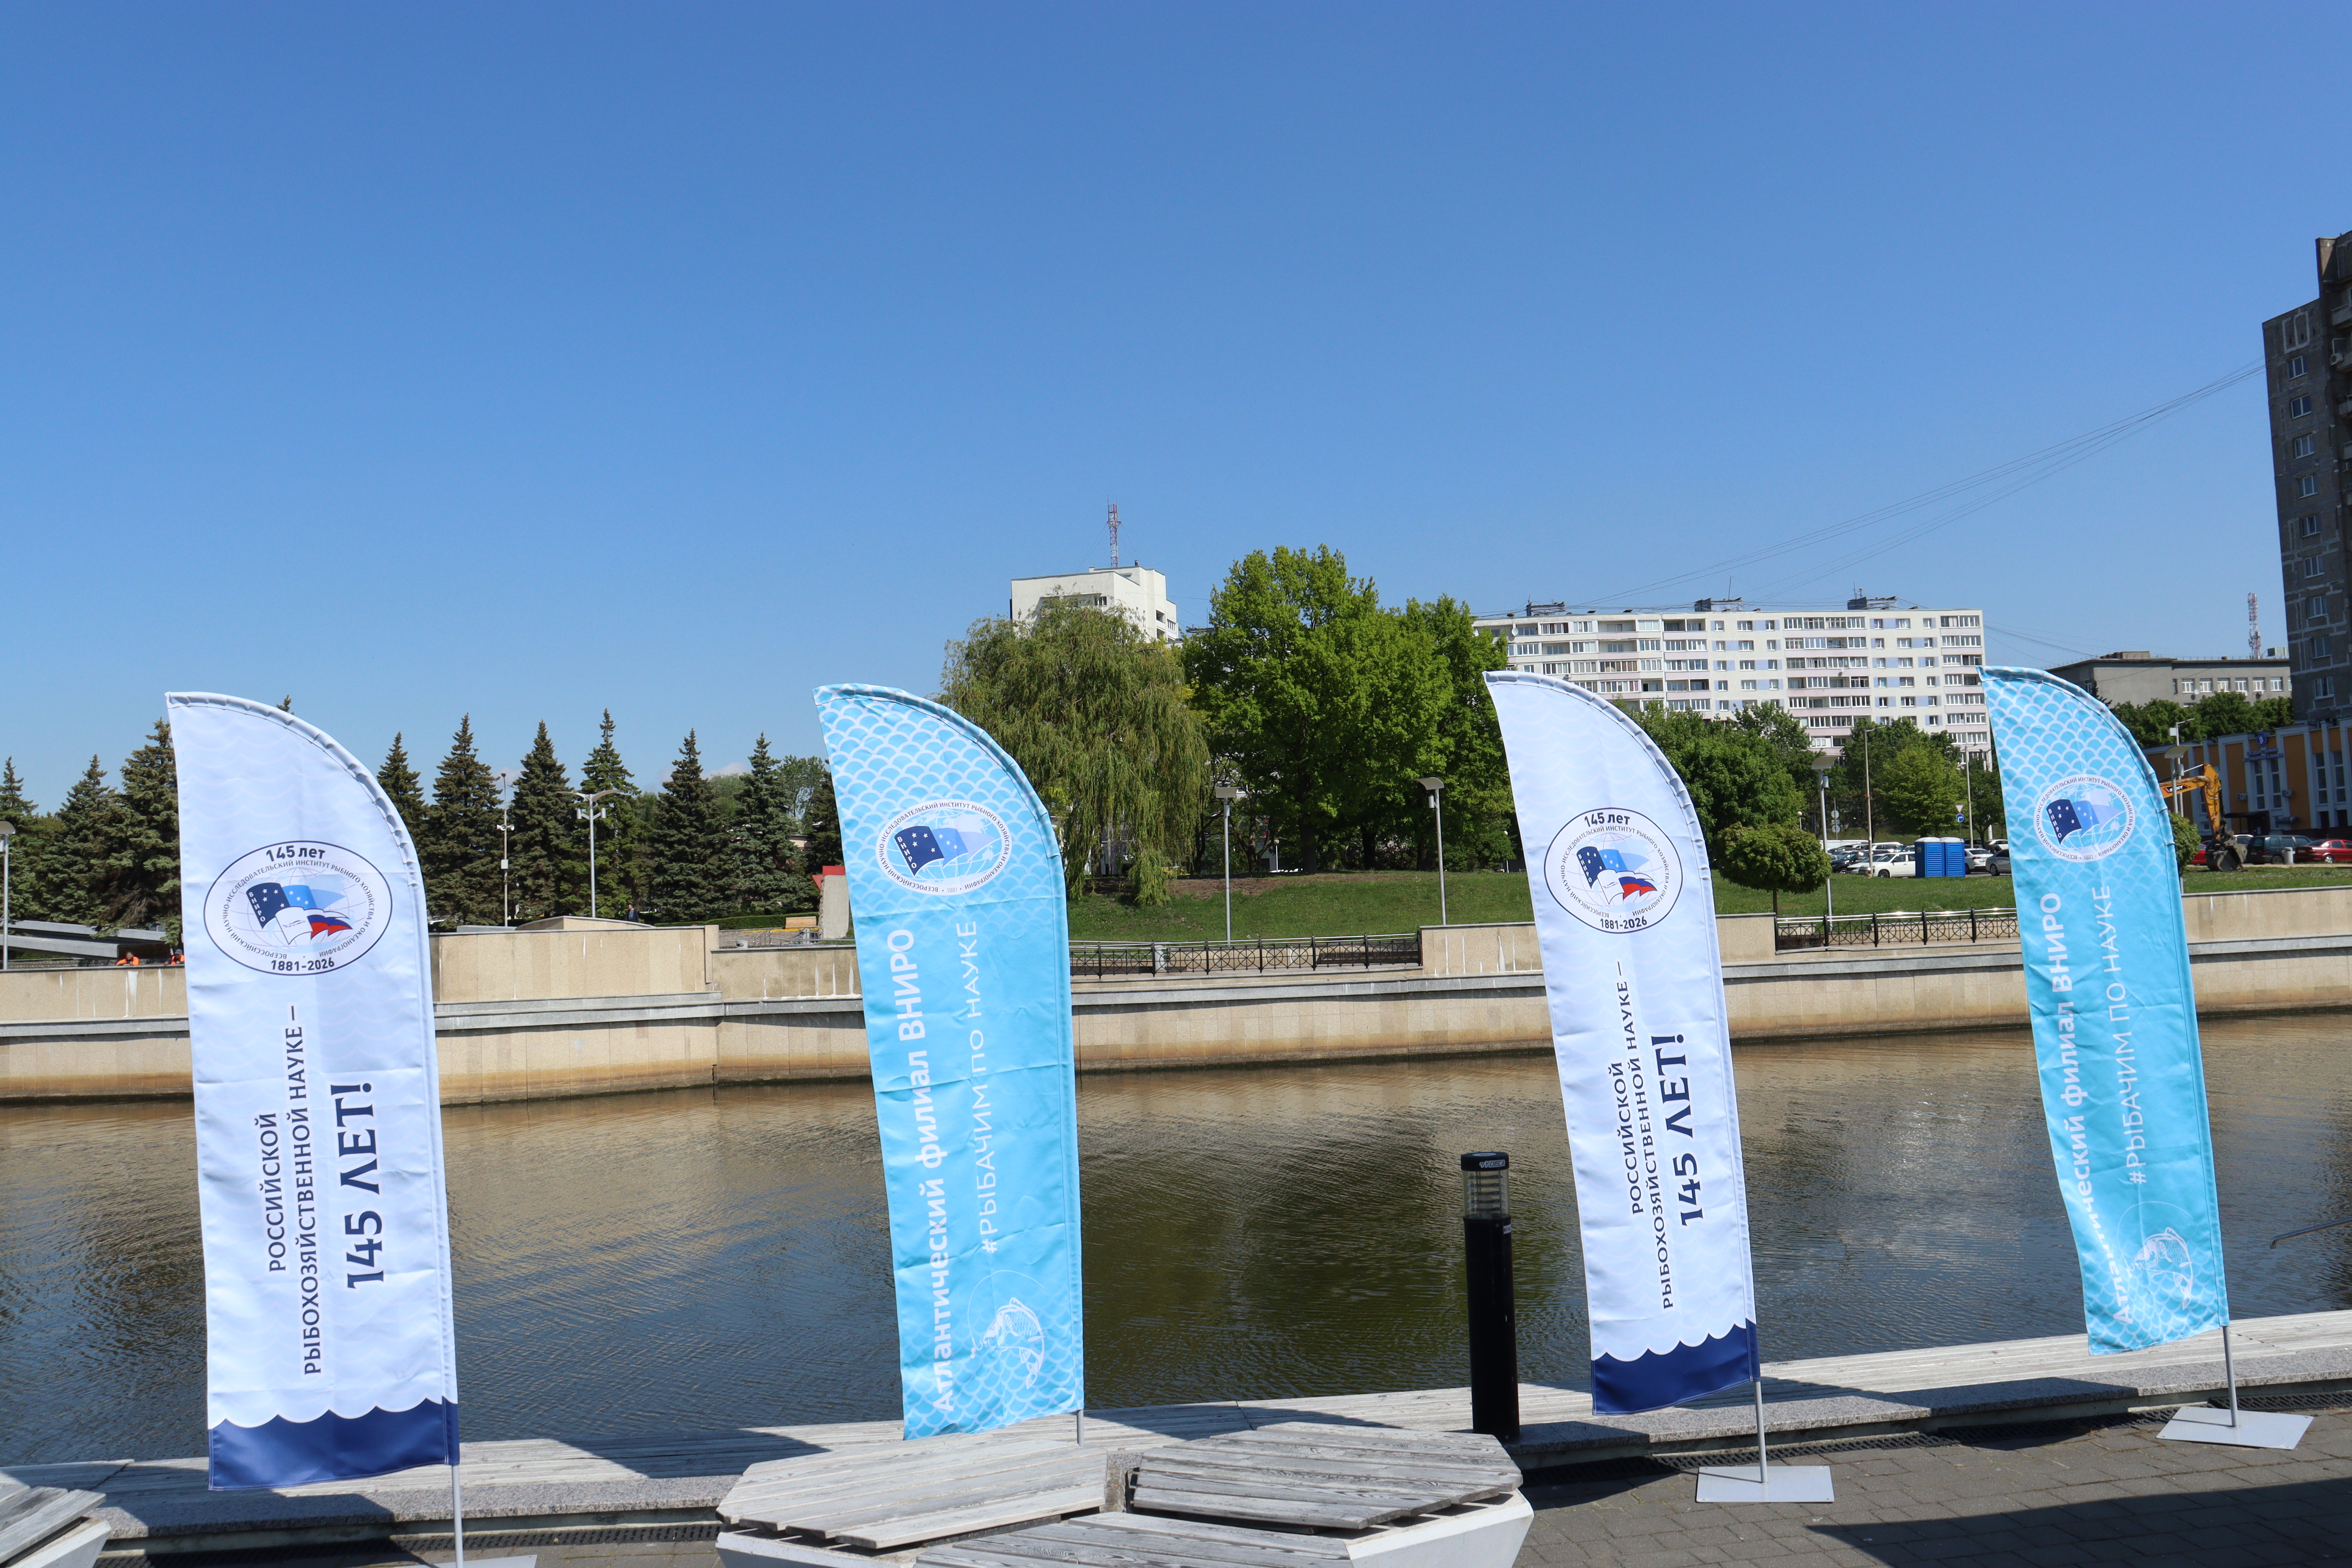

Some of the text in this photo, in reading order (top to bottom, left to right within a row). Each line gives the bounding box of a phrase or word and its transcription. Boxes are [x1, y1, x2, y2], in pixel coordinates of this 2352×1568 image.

[2101, 780, 2122, 795] РЫБНОГО
[971, 805, 997, 821] РЫБНОГО
[1584, 812, 1630, 827] 145 лет
[2036, 777, 2077, 839] НАУЧНО-ИССЛЕДОВАТЕЛЬСКИЙ
[2048, 808, 2062, 838] ВНИРО
[2121, 794, 2133, 826] ХОЗЯЙСТВА
[879, 802, 938, 869] НАУЧНО-ИССЛЕДОВАТЕЛЬСКИЙ
[996, 820, 1010, 855] ХОЗЯЙСТВА
[1637, 829, 1658, 848] РЫБНОГО
[2043, 838, 2078, 860] ВСЕРОССИЙСКИЙ
[2098, 833, 2128, 856] ОКЕАНОГРАФИИ
[266, 846, 325, 862] 145 лет
[897, 836, 917, 869] ВНИРО
[1561, 826, 1604, 891] НАУЧНО-ИССЛЕДОВАТЕЛЬСКИЙ
[1578, 854, 1592, 883] ВНИРО
[1657, 848, 1670, 884] ХОЗЯЙСТВА
[331, 865, 361, 882] РЫБНОГО
[887, 869, 938, 892] ВСЕРОССИЙСКИЙ
[965, 862, 1003, 889] ОКЕАНОГРАФИИ
[223, 860, 293, 933] НАУЧНО-ИССЛЕДОВАТЕЛЬСКИЙ
[249, 892, 265, 922] ВНИРО
[359, 882, 375, 920] ХОЗЯЙСТВА
[1570, 891, 1609, 918] ВСЕРОССИЙСКИЙ
[1632, 890, 1667, 916] ОКЕАНОГРАФИИ
[1600, 916, 1647, 929] 1881-2026
[230, 932, 287, 959] ВСЕРОССИЙСКИЙ
[319, 927, 366, 957] ОКЕАНОГРАФИИ
[2041, 893, 2072, 992] ВНИРО
[271, 958, 334, 971] 1881-2026
[1617, 982, 1637, 1050] НАУКЕ
[2092, 886, 2147, 1184] #РЫБАЧИМ ПО НАУКЕ
[286, 1027, 306, 1100] НАУКЕ
[2058, 1002, 2088, 1106] филиал
[956, 921, 999, 1254] #РЫБАЧИМ ПО НАУКЕ
[1608, 1063, 1643, 1214] РОССИЙСКОЙ
[1651, 1034, 1703, 1226] 145 ЛЕТ!
[331, 1083, 383, 1288] 145 ЛЕТ!
[887, 929, 953, 1412] Атлантический филиал ВНИРО
[1628, 1058, 1673, 1308] РЫБОХОЗЯЙСТВЕННОЙ
[255, 1114, 285, 1272] РОССИЙСКОЙ
[287, 1108, 320, 1374] РЫБОХОЗЯЙСТВЕННОЙ
